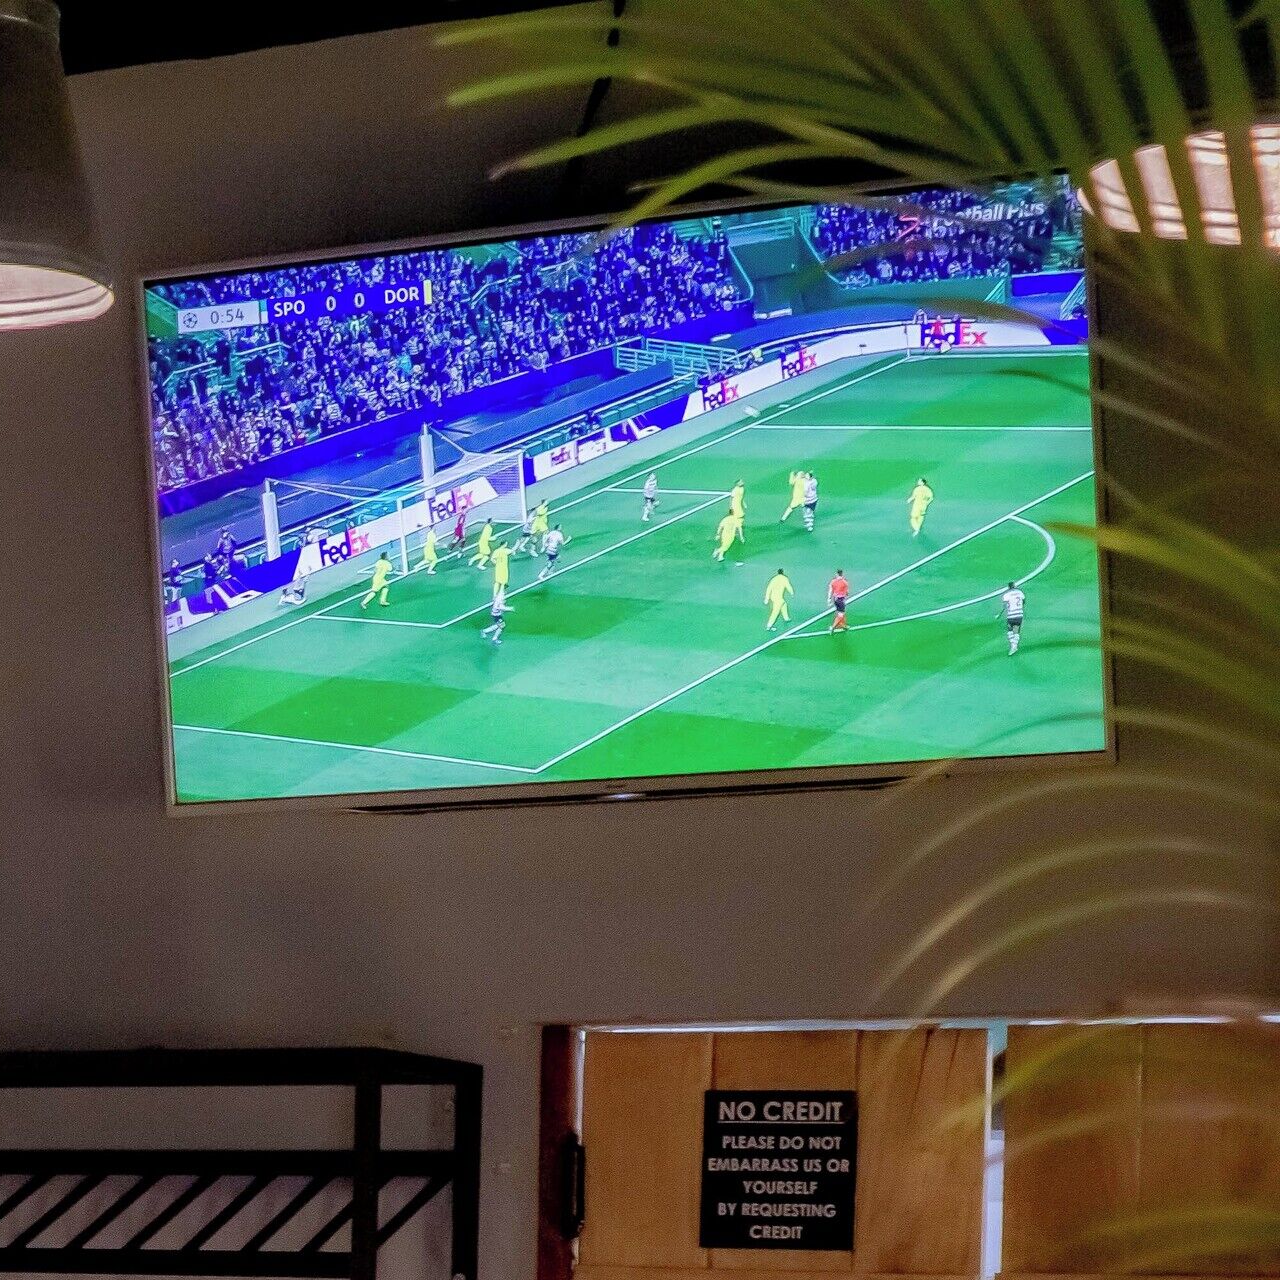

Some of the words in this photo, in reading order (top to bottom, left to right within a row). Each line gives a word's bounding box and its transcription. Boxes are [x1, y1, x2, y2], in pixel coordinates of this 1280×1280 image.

[209, 308, 245, 325] 0:54
[273, 299, 306, 318] SPO
[325, 295, 337, 312] 0
[353, 292, 365, 308] 0
[384, 286, 420, 305] DOR
[700, 377, 740, 411] FedEx
[428, 487, 474, 524] FedEx
[319, 527, 371, 567] FedEx
[718, 1101, 756, 1121] NO
[763, 1101, 844, 1121] CREDIT
[722, 1135, 775, 1149] PLEASE
[779, 1136, 805, 1149] DO
[809, 1136, 842, 1150] NOT
[707, 1158, 799, 1172] EMBARRASS
[803, 1158, 822, 1172] US
[826, 1158, 850, 1172] OR
[742, 1180, 818, 1194] YOURSELF
[717, 1202, 737, 1216] BY
[741, 1202, 837, 1217] REQUESTING
[749, 1225, 804, 1239] CREDIT
